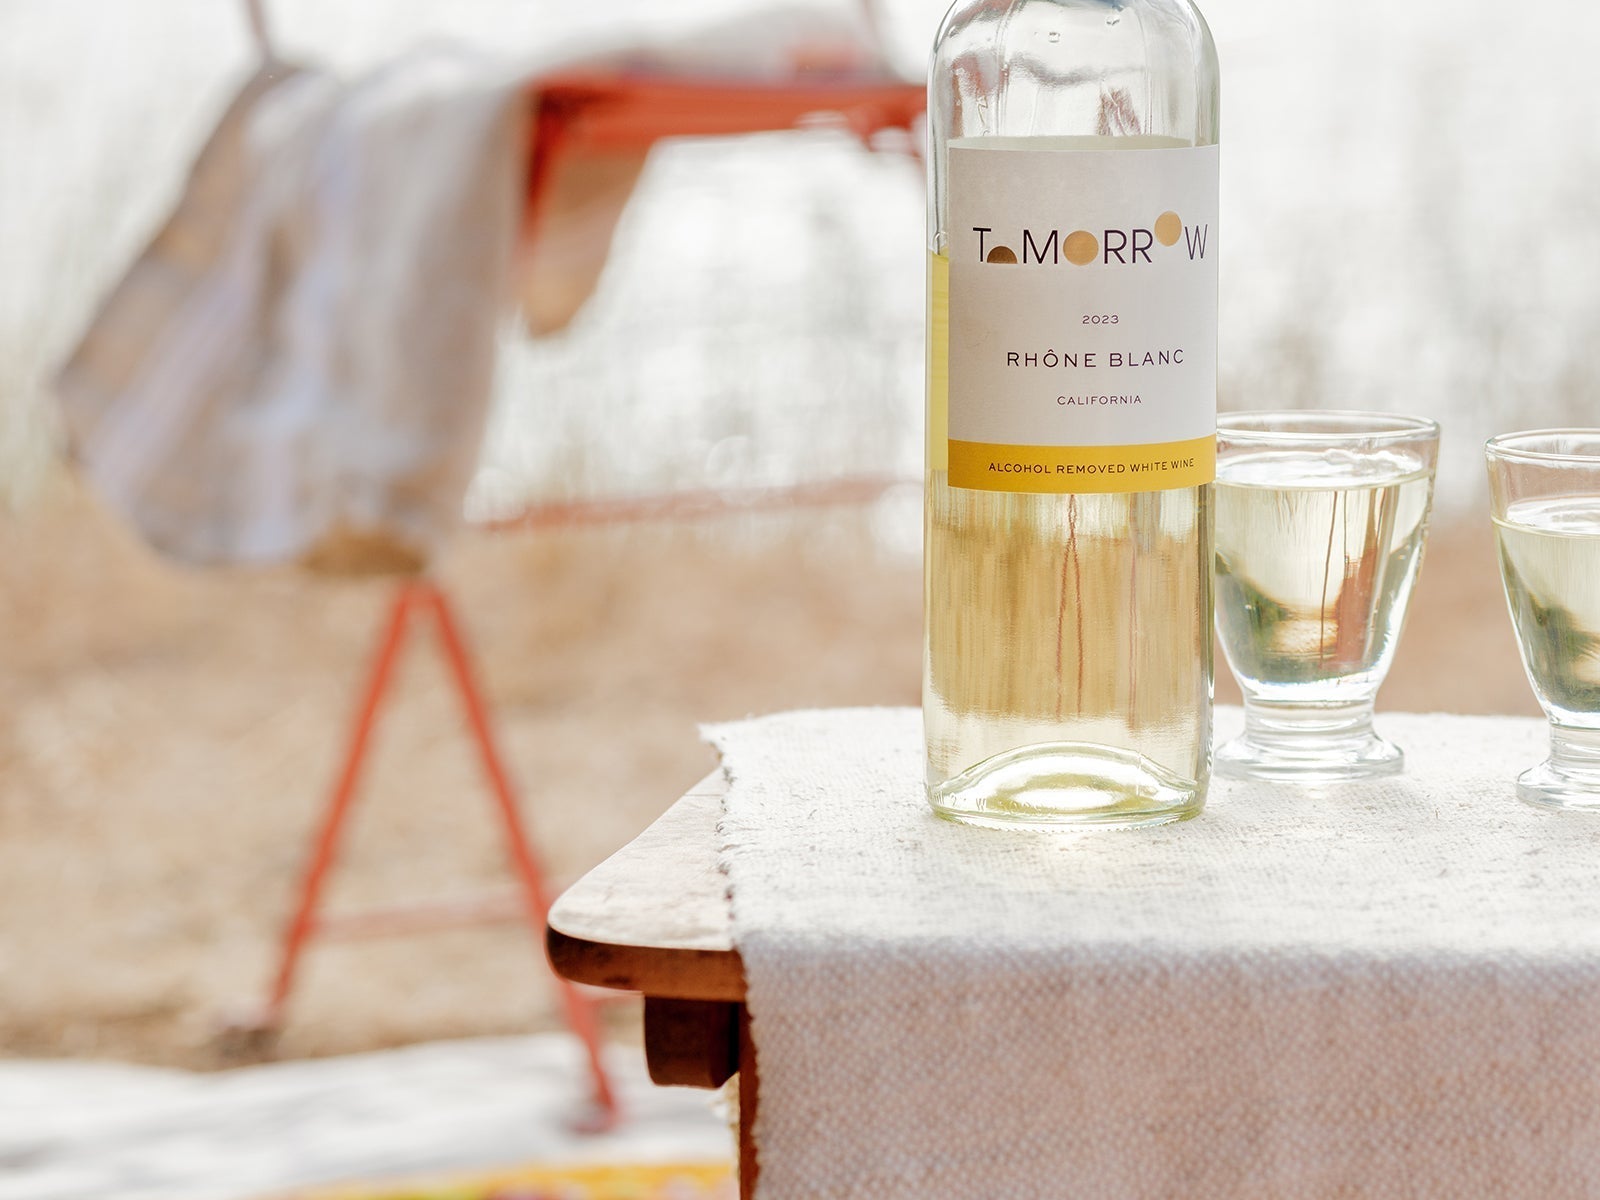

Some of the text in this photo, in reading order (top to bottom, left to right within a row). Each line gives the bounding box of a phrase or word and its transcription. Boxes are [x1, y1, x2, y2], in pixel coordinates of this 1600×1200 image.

[1082, 314, 1120, 325] 2023
[1006, 349, 1184, 368] RHÔNE BLANC
[1057, 395, 1142, 406] CALIFORNIA
[988, 458, 1195, 474] ALCOHOL REMOVED WHITE WINE
